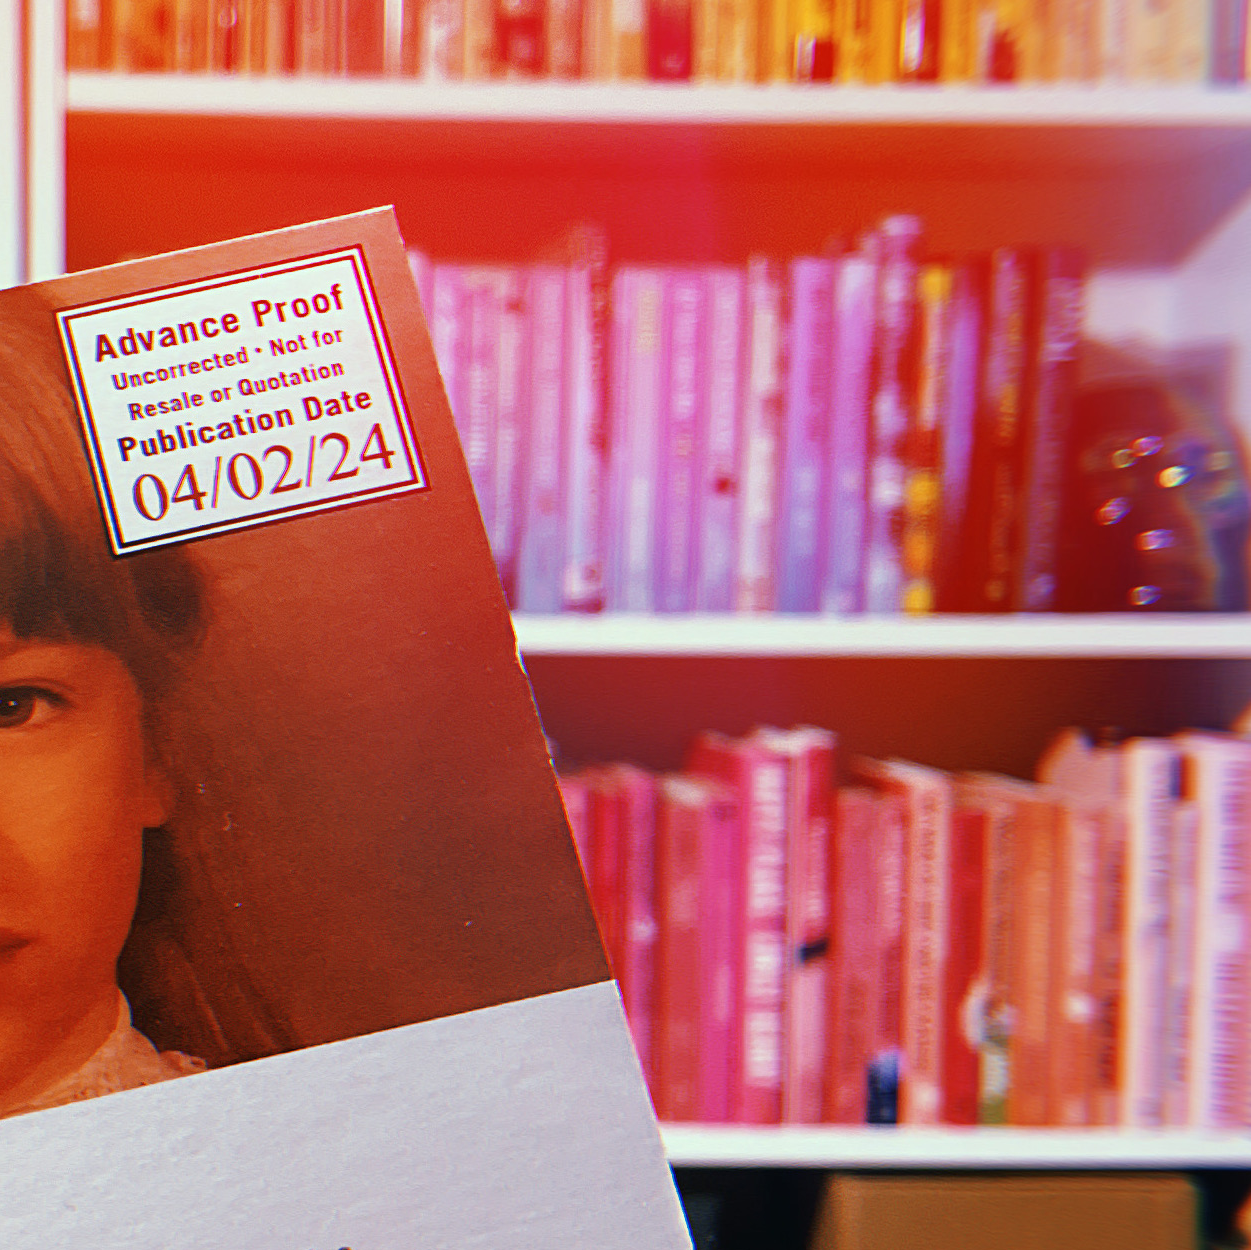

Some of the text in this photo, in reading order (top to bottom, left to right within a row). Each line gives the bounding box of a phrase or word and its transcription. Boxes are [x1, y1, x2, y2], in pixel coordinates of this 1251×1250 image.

[94, 282, 345, 362] Advance Proof
[111, 328, 344, 391] Uncorrected Not for
[128, 360, 345, 421] Resale or Quotation
[117, 390, 373, 462] Publication Date
[131, 422, 396, 522] 04/02/24
